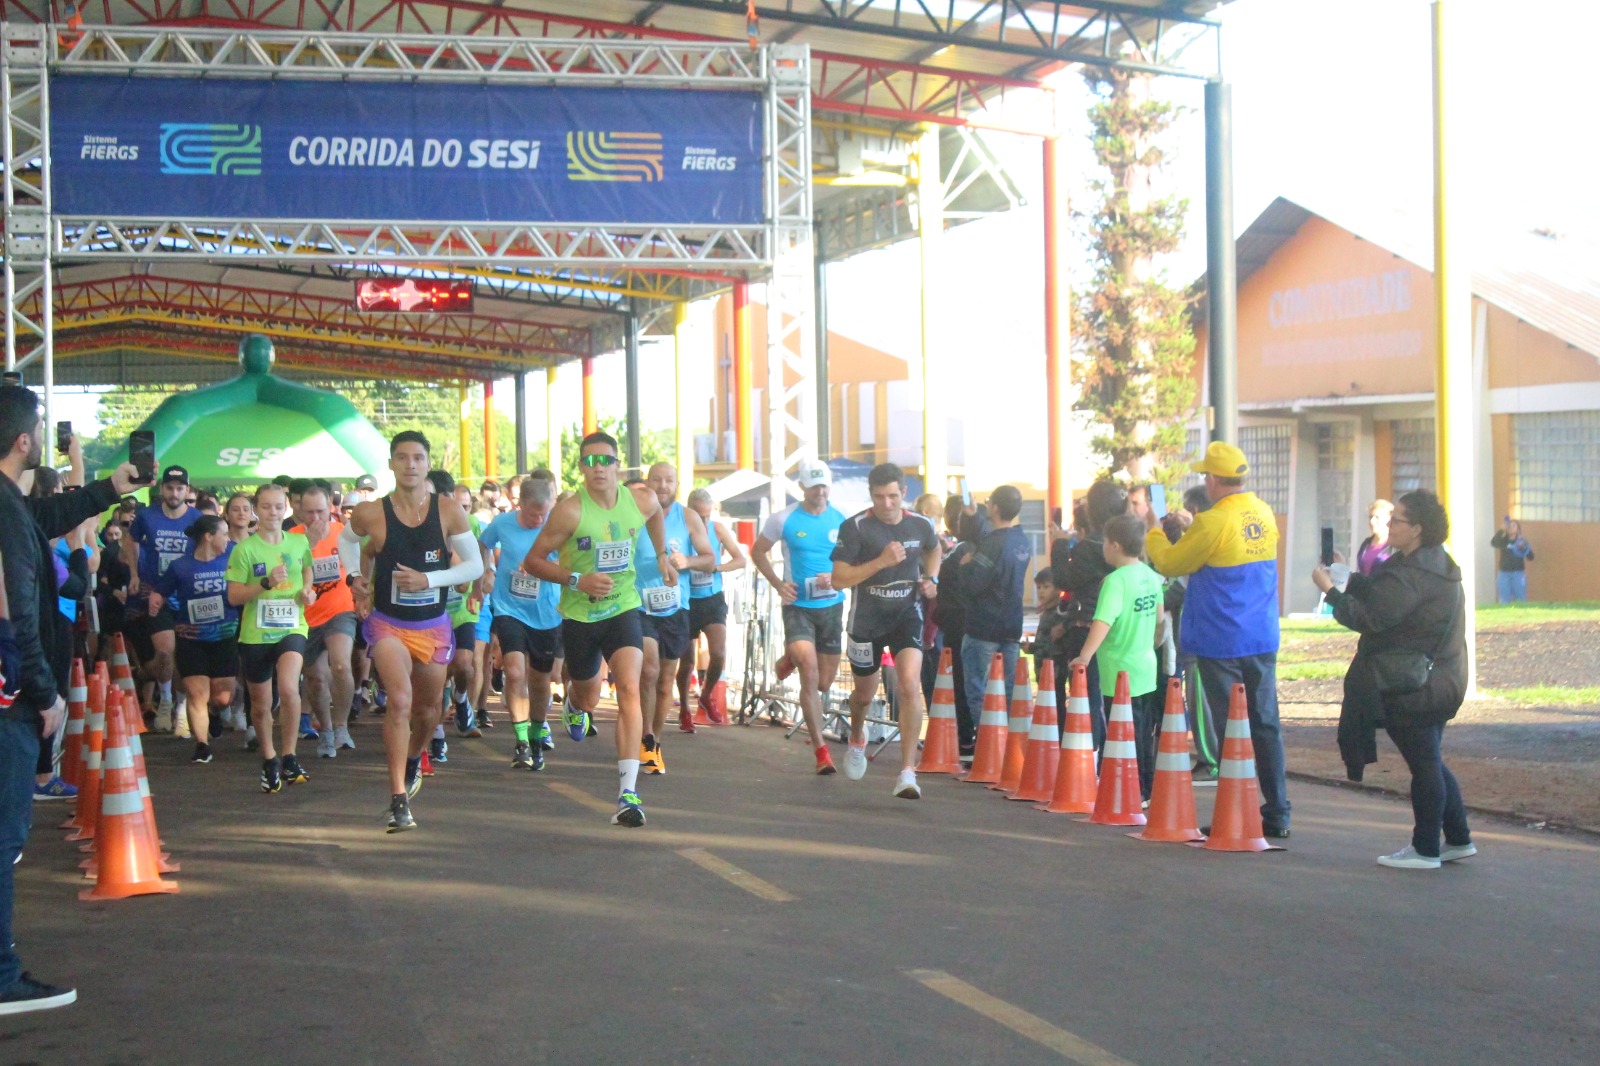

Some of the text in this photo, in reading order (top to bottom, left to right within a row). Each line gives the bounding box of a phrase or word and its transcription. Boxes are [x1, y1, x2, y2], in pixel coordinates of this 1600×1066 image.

[83, 134, 118, 144] Sistema
[289, 136, 415, 166] CORRIDA
[421, 139, 463, 168] DO
[1249, 525, 1260, 538] L
[602, 547, 629, 560] 5138
[316, 561, 338, 572] 5130
[193, 571, 220, 579] CORRIDA
[514, 578, 537, 589] 5154
[652, 592, 676, 603] 5165
[268, 607, 293, 616] 5114
